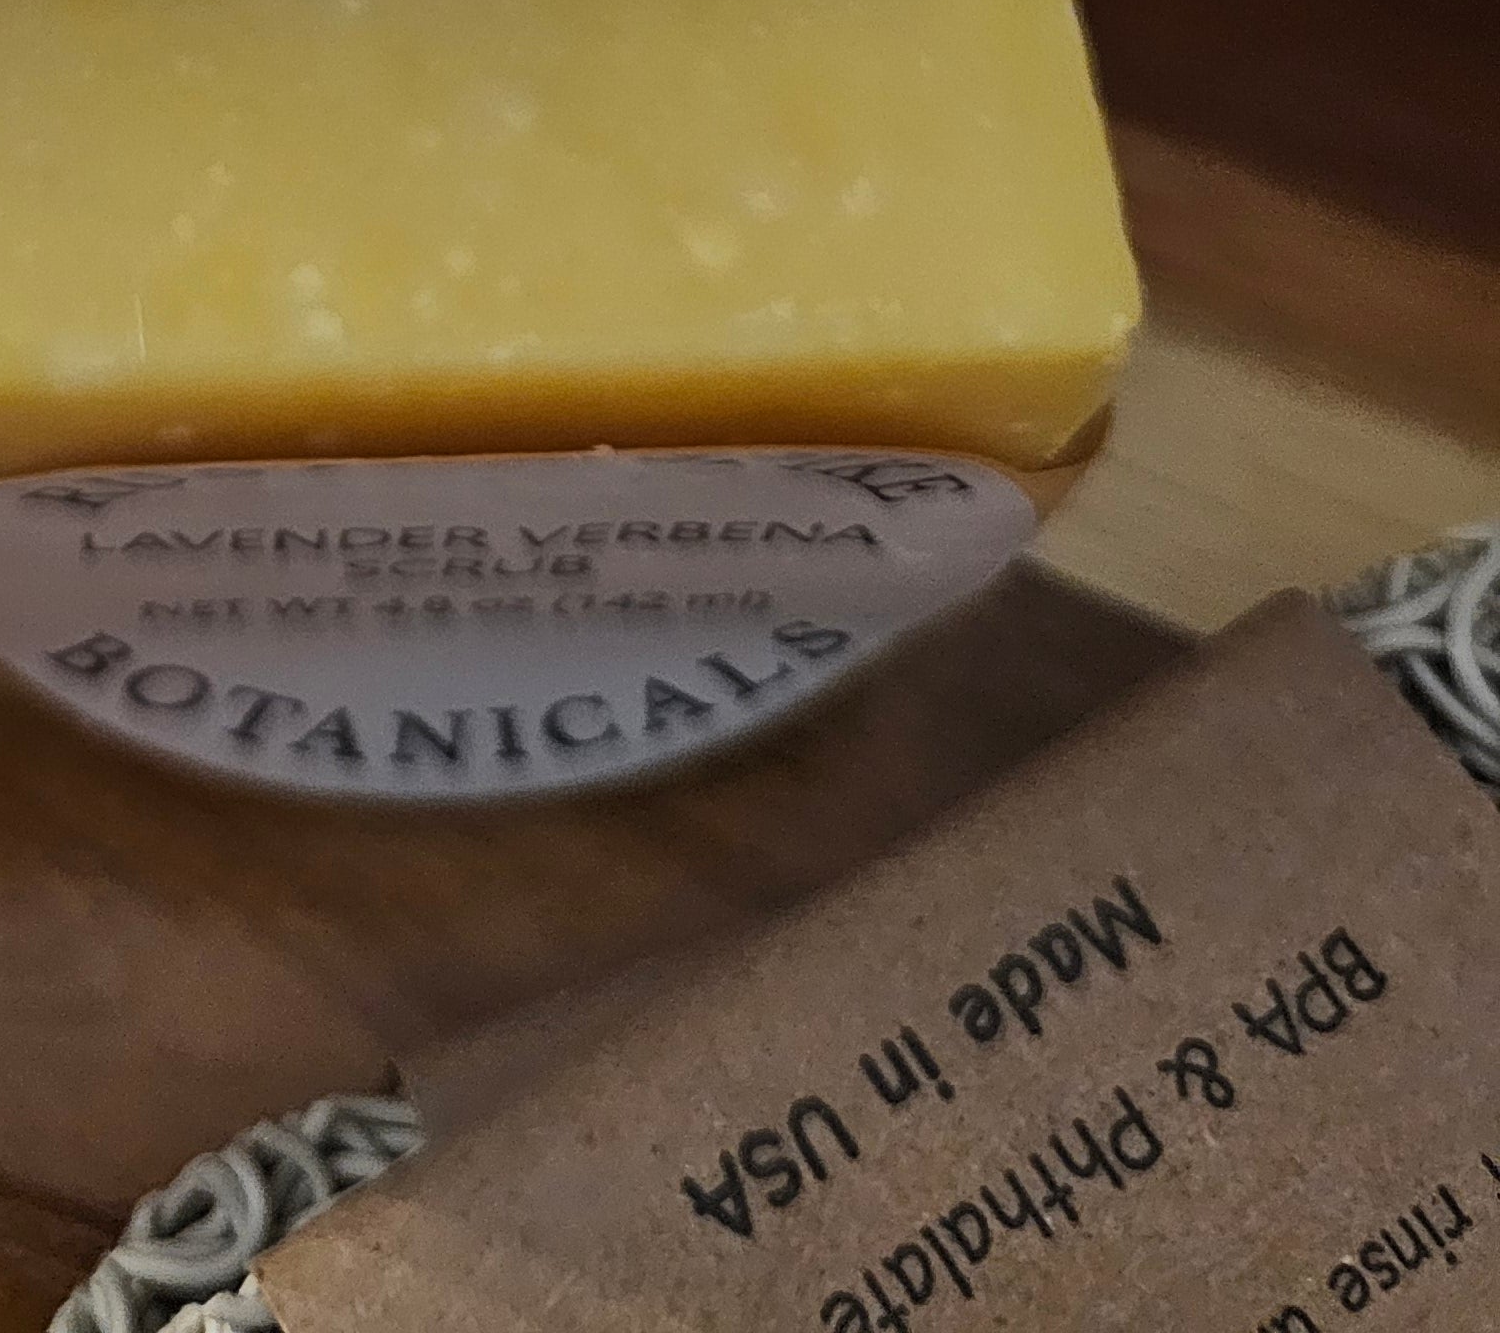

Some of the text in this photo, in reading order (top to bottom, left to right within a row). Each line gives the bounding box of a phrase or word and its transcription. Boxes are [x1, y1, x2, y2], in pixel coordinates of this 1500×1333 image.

[80, 519, 879, 553] LAVENDER VERBENA
[343, 554, 594, 579] SCRUB
[45, 617, 855, 764] BOTANICALS
[680, 874, 1163, 1238] Made in USA
[1231, 927, 1389, 1057] BPA
[1155, 1037, 1235, 1109] &
[1326, 1183, 1474, 1313] rinse
